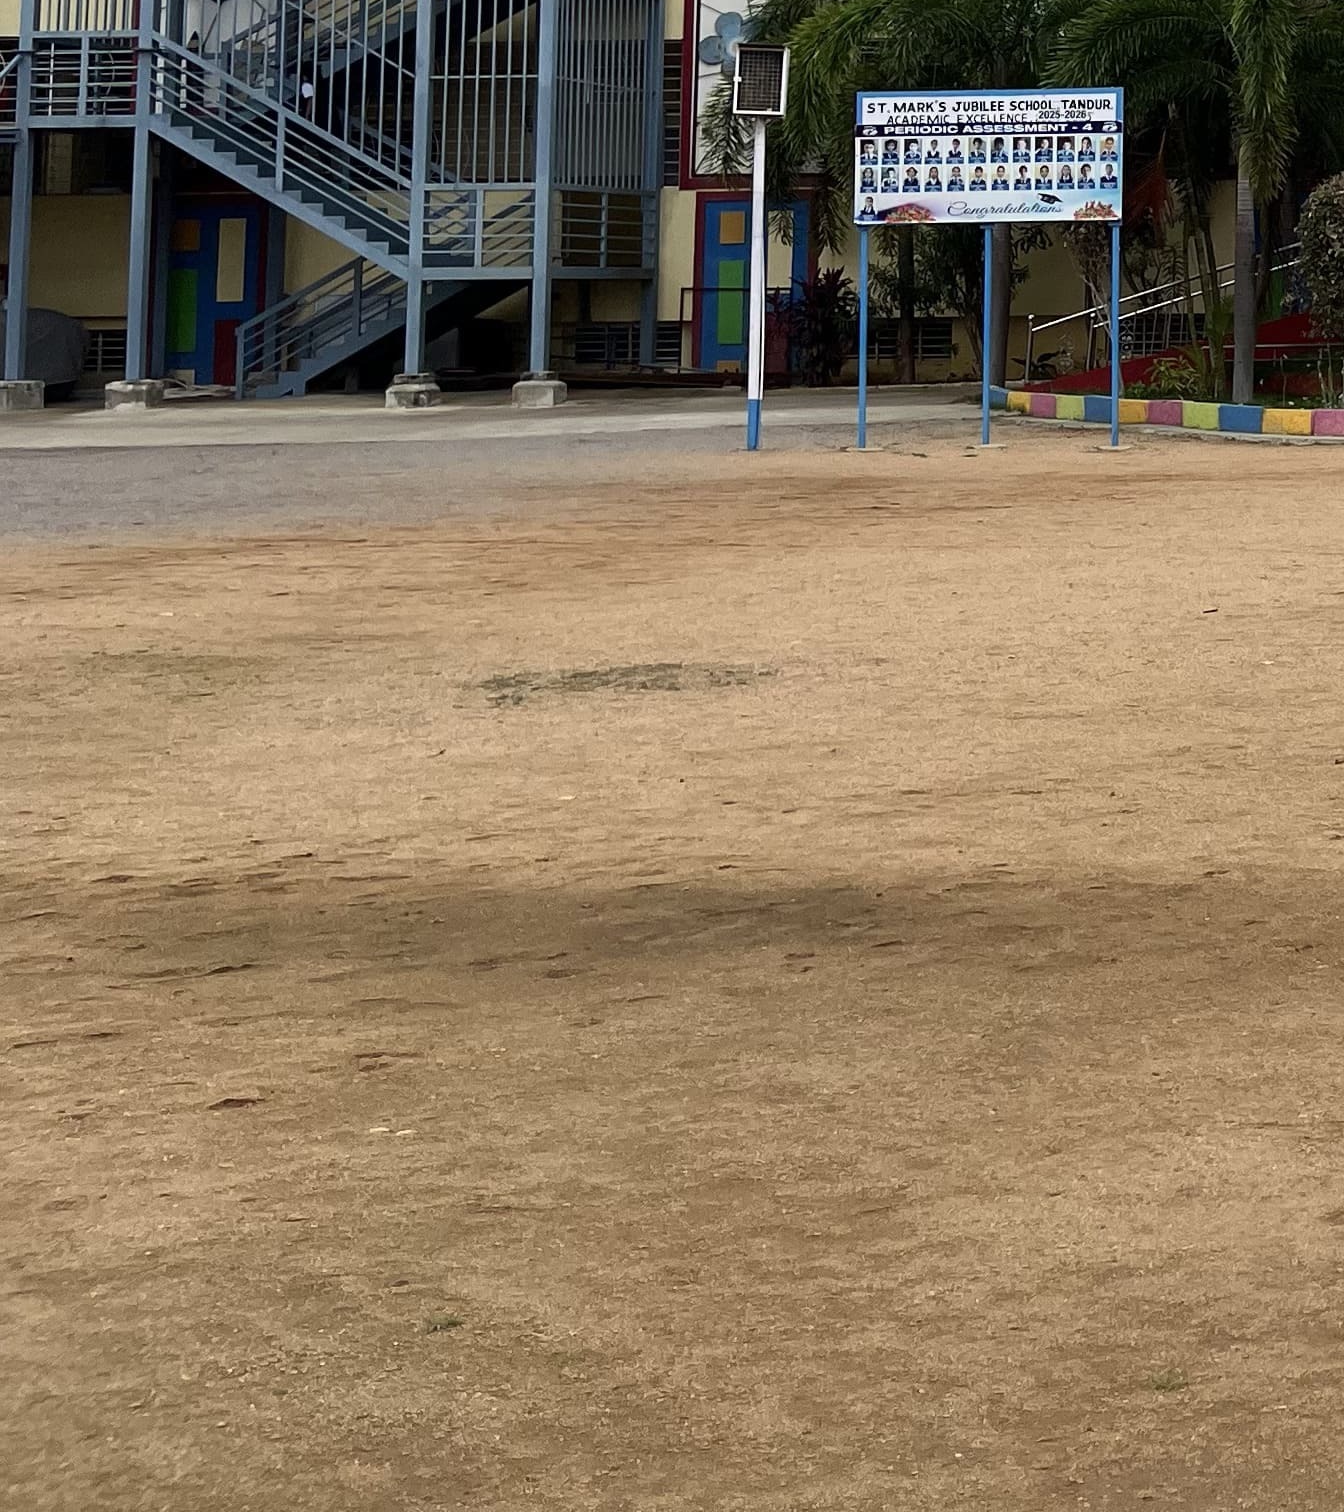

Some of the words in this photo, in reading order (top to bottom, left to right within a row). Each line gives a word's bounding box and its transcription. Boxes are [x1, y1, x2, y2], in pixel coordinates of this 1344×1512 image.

[867, 102, 890, 113] ST.
[893, 100, 946, 113] MARK'S
[952, 100, 1004, 112] JUBILEE
[887, 114, 950, 125] ACADEMIC
[957, 113, 1027, 124] EXCELLENCE
[1038, 110, 1087, 119] 2025-2026
[884, 125, 958, 135] PERIODIC
[963, 123, 1068, 133] ASSESSMENT
[1082, 123, 1093, 131] 4
[947, 200, 1063, 219] Congratulations
